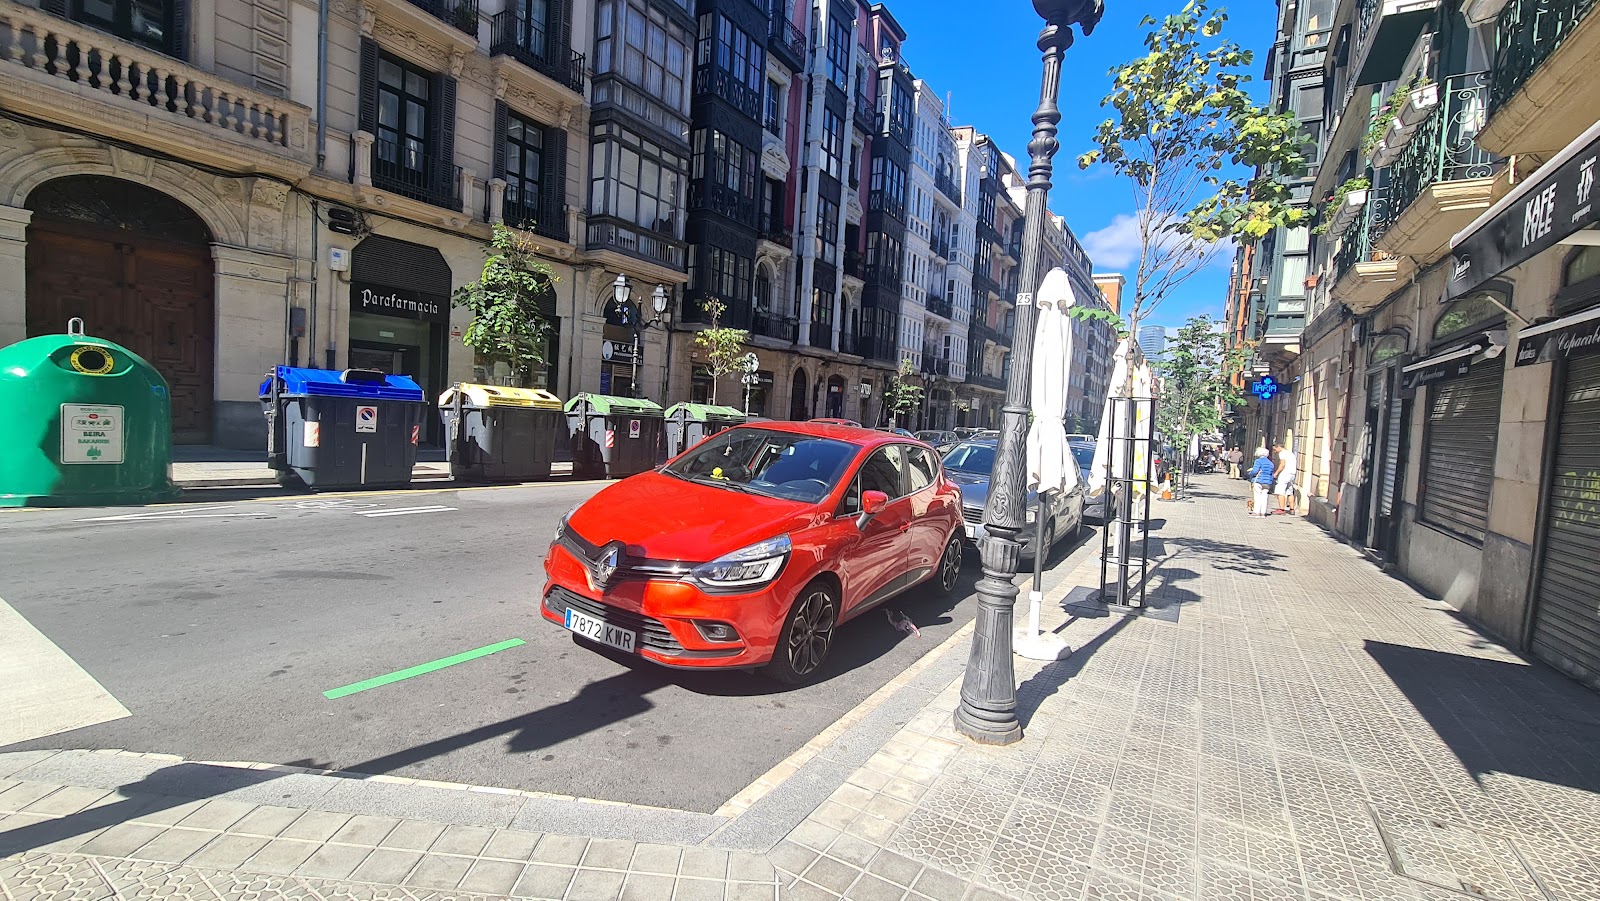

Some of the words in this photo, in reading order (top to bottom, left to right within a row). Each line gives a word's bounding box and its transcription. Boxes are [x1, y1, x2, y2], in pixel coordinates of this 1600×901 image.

[361, 288, 438, 314] Parafarmacia
[1018, 294, 1031, 304] 25
[573, 613, 602, 639] 7872
[605, 626, 632, 649] KWR
